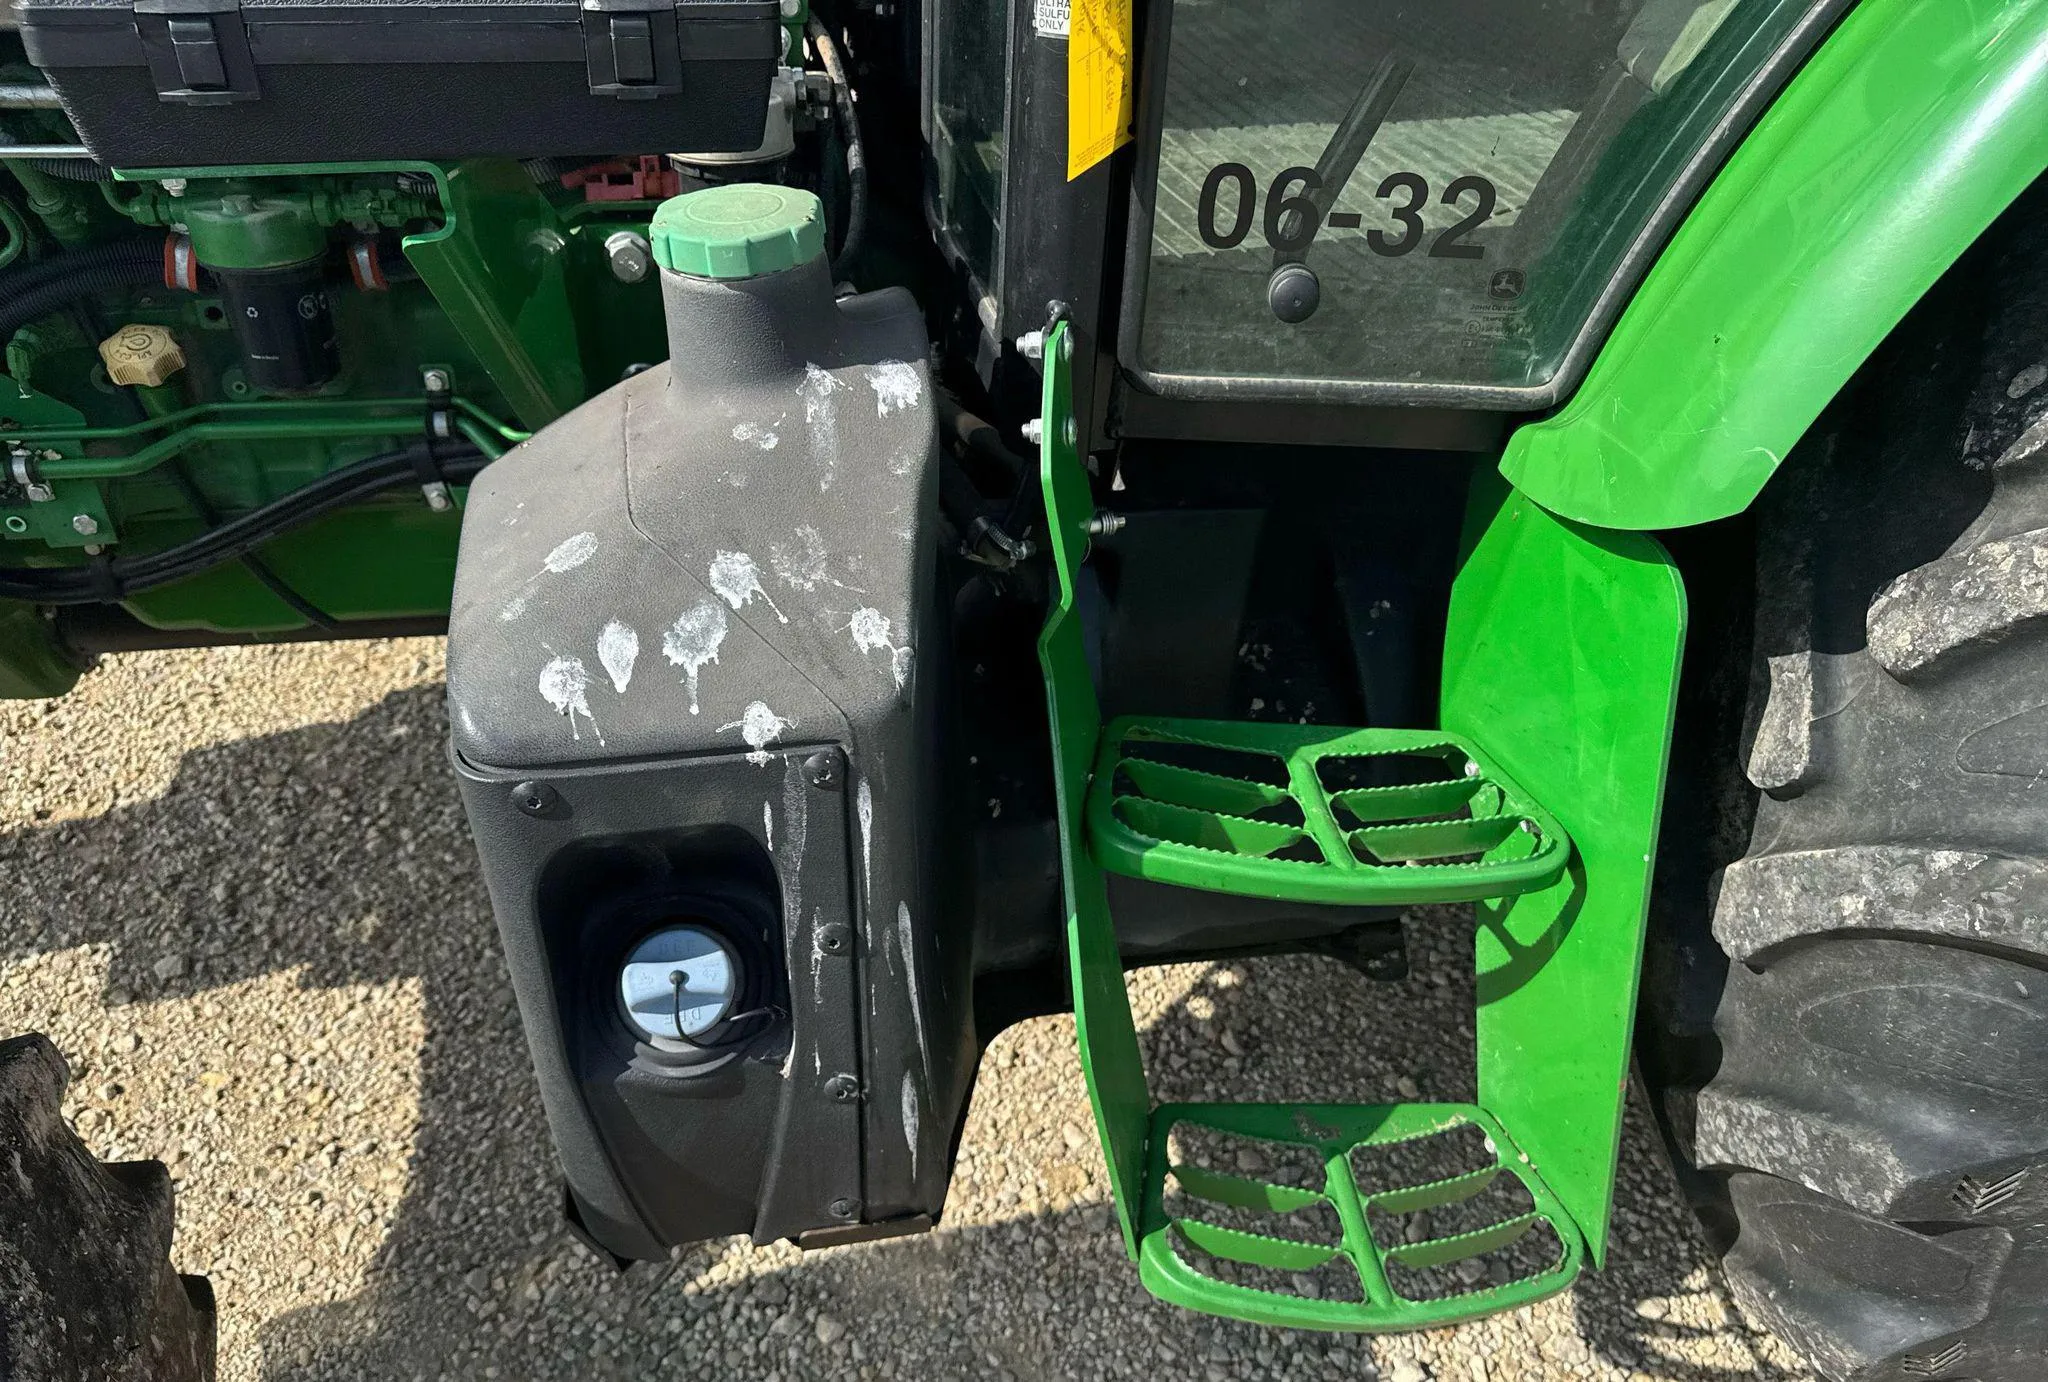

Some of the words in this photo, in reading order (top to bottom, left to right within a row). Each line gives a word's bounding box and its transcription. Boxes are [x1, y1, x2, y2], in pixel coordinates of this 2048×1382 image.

[1039, 7, 1070, 20] SULFU
[1039, 18, 1063, 30] ONLY
[1198, 162, 1497, 260] 06-32
[1469, 303, 1491, 311] JOHN
